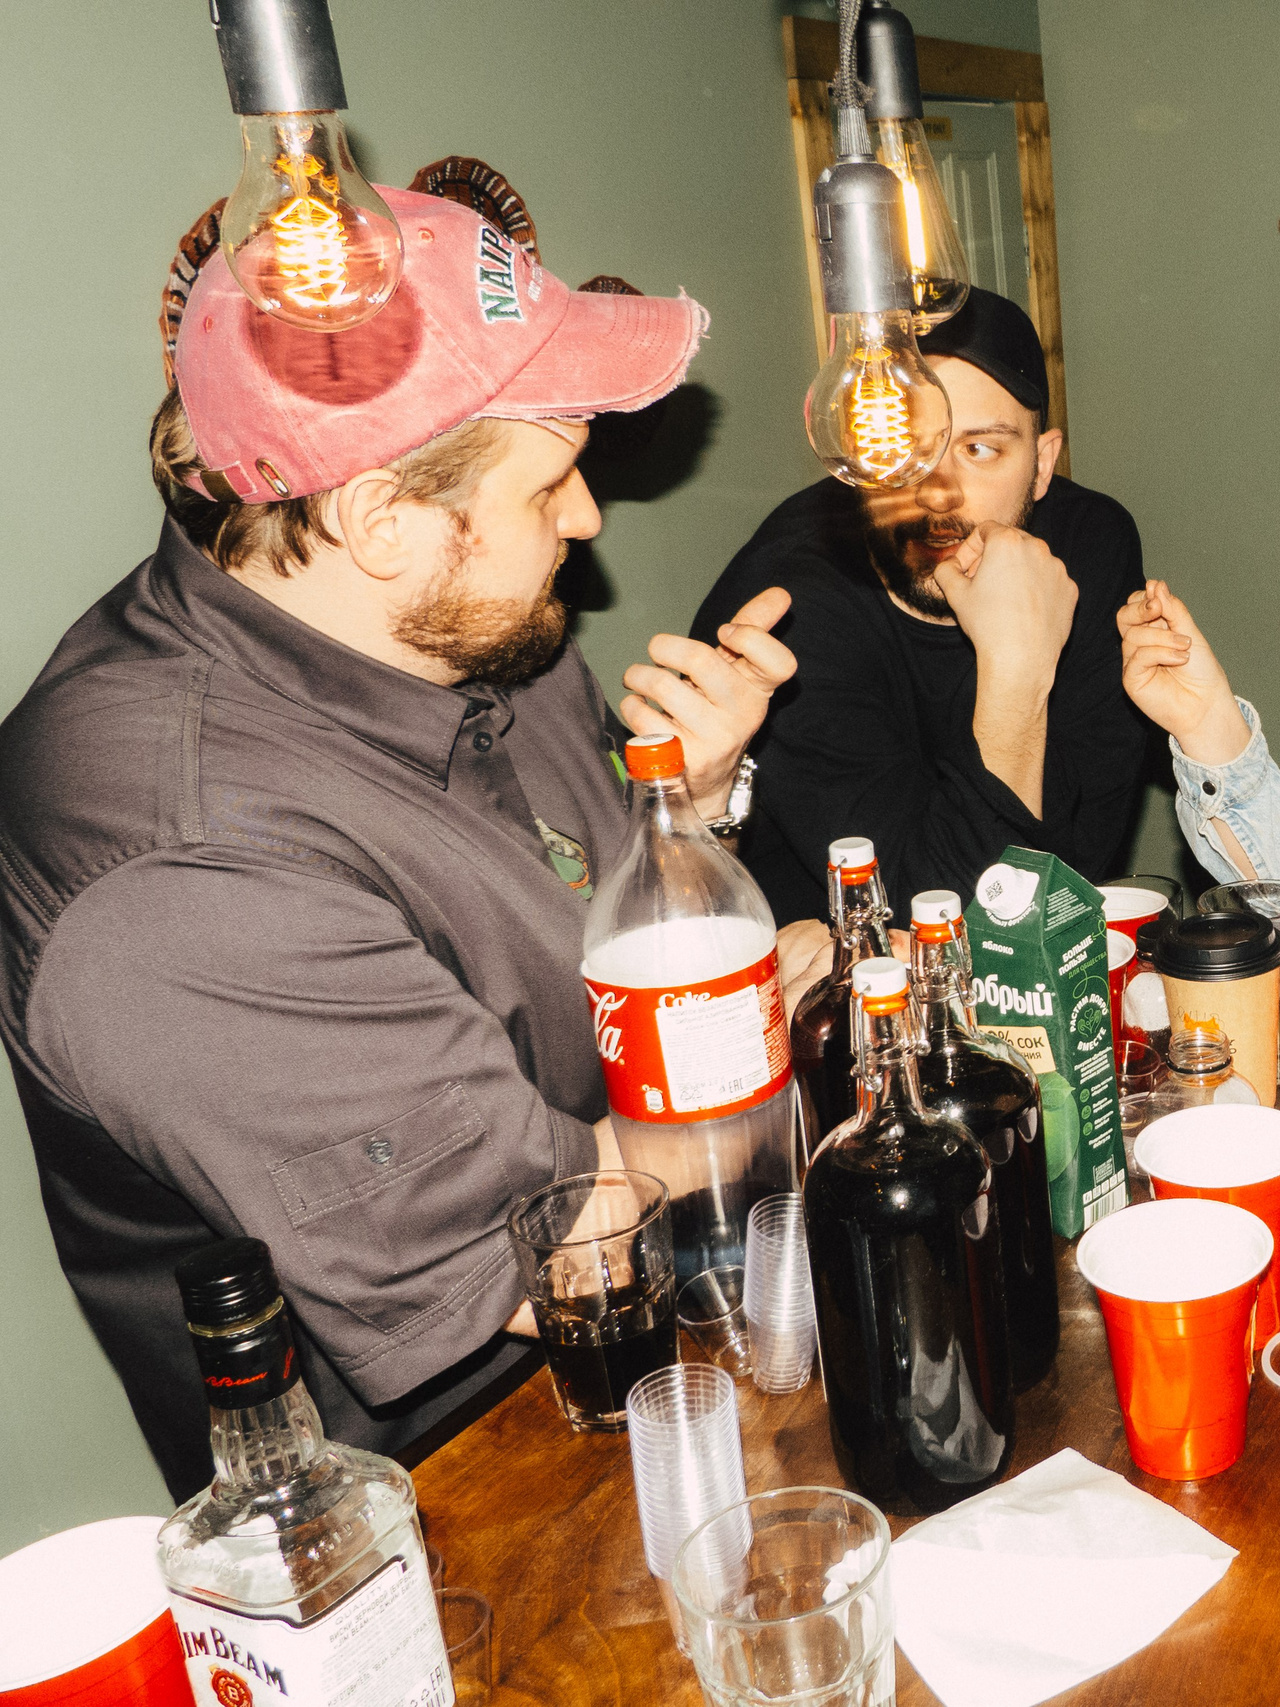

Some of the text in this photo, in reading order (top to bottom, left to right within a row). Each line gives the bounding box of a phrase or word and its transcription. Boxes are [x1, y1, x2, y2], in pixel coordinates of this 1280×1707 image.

[477, 217, 524, 323] NAIP
[982, 940, 1014, 955] яблоко
[1058, 950, 1088, 976] ПОЛЬЗЫ
[1062, 935, 1094, 962] БОЛЬШЕ
[658, 991, 711, 1009] Coke
[972, 974, 1053, 1017] обрый
[1069, 993, 1108, 1033] РАСТИМ ДОБРО
[1077, 1027, 1107, 1051] ВМЕСТЕ
[335, 1586, 382, 1626] QUALITY
[210, 1626, 289, 1697] BEAM
